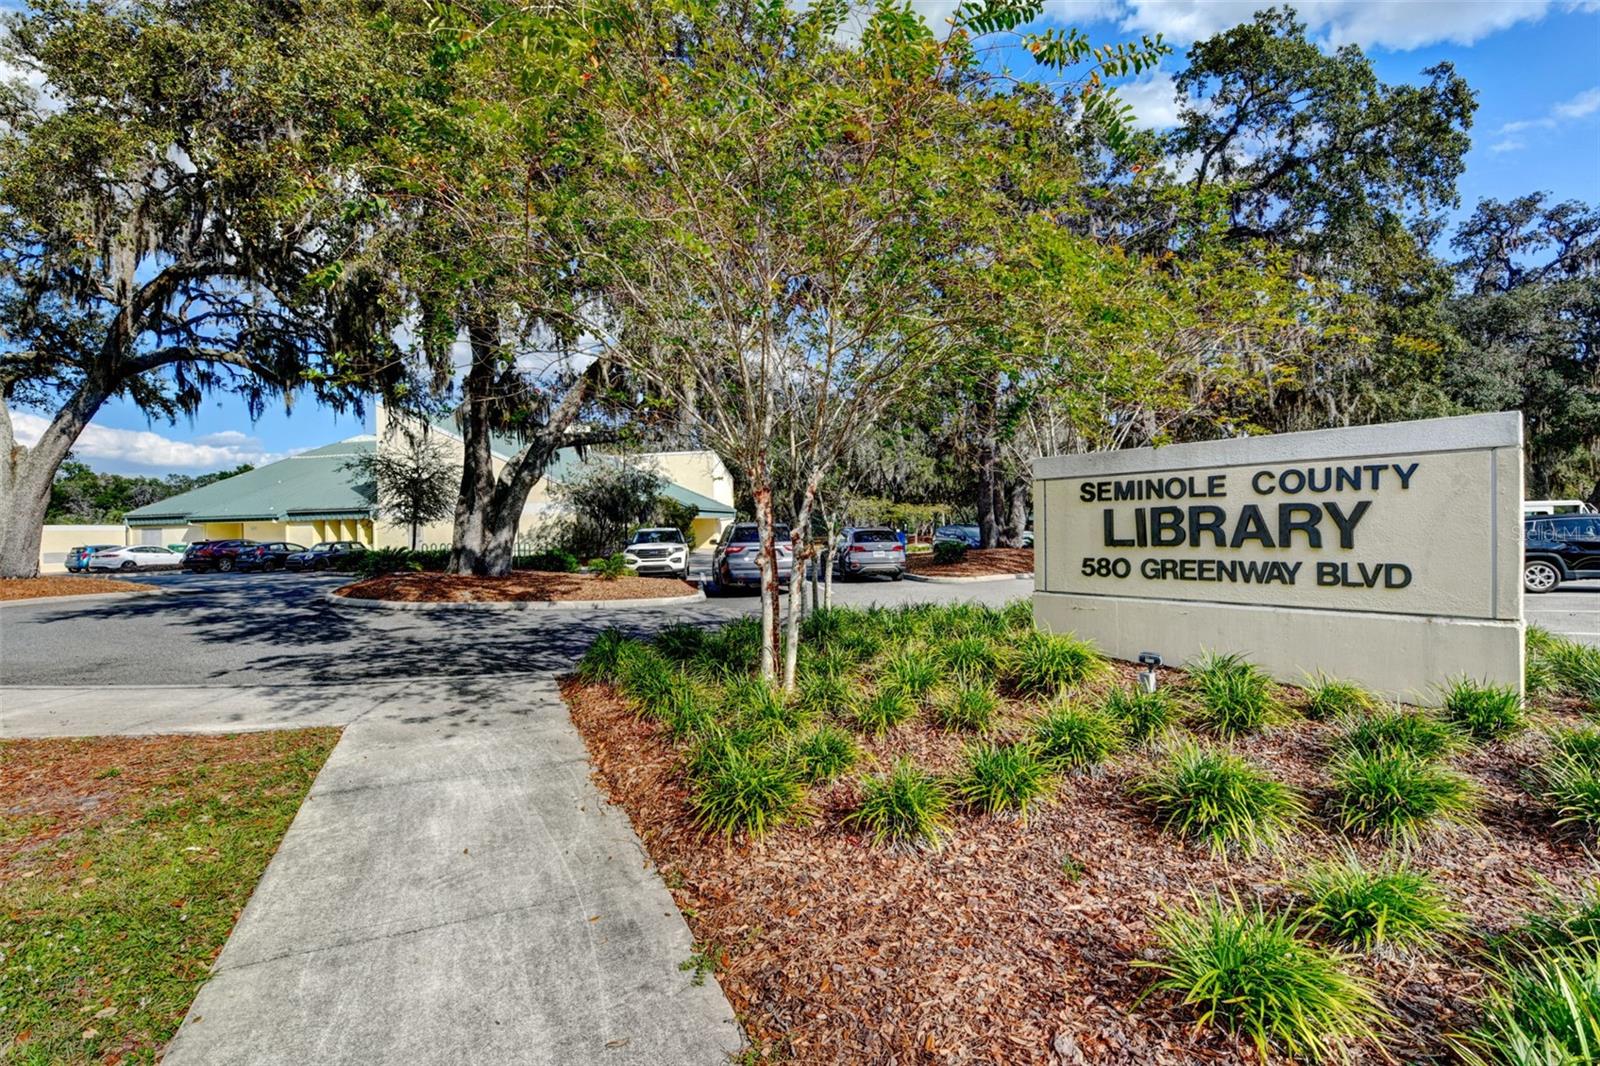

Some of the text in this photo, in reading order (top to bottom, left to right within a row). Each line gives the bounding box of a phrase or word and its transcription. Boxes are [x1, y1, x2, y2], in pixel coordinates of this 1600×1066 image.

[1081, 463, 1420, 503] SEMINOLE COUNTY
[1104, 501, 1373, 550] LIBRARY
[1081, 558, 1414, 590] 580 GREENWAY BLVD
